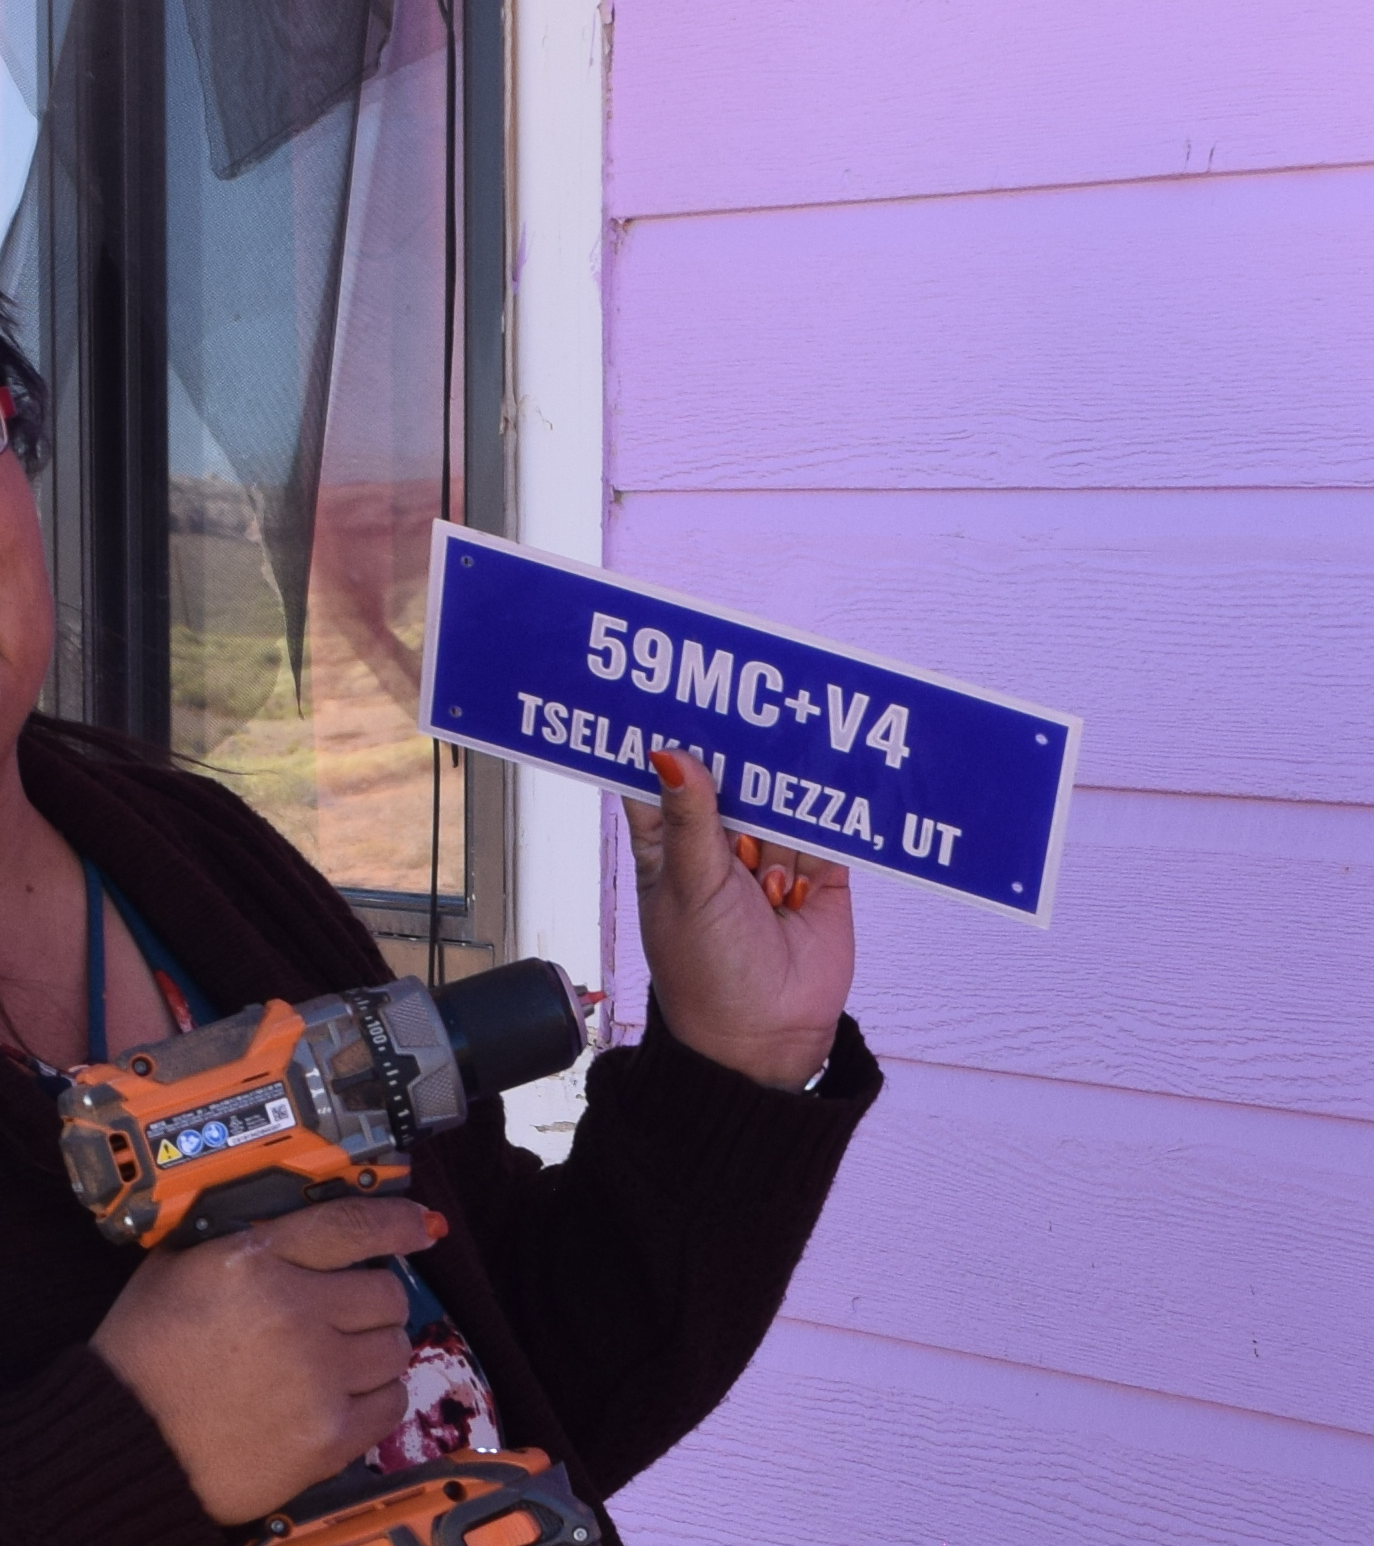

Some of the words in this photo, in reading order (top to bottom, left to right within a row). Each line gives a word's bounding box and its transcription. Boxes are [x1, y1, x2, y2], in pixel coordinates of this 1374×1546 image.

[586, 611, 910, 770] 59MC+V4
[517, 691, 725, 794] TSELAI
[740, 760, 884, 851] DEZZA,
[902, 812, 962, 867] UT
[366, 1020, 388, 1044] 100
